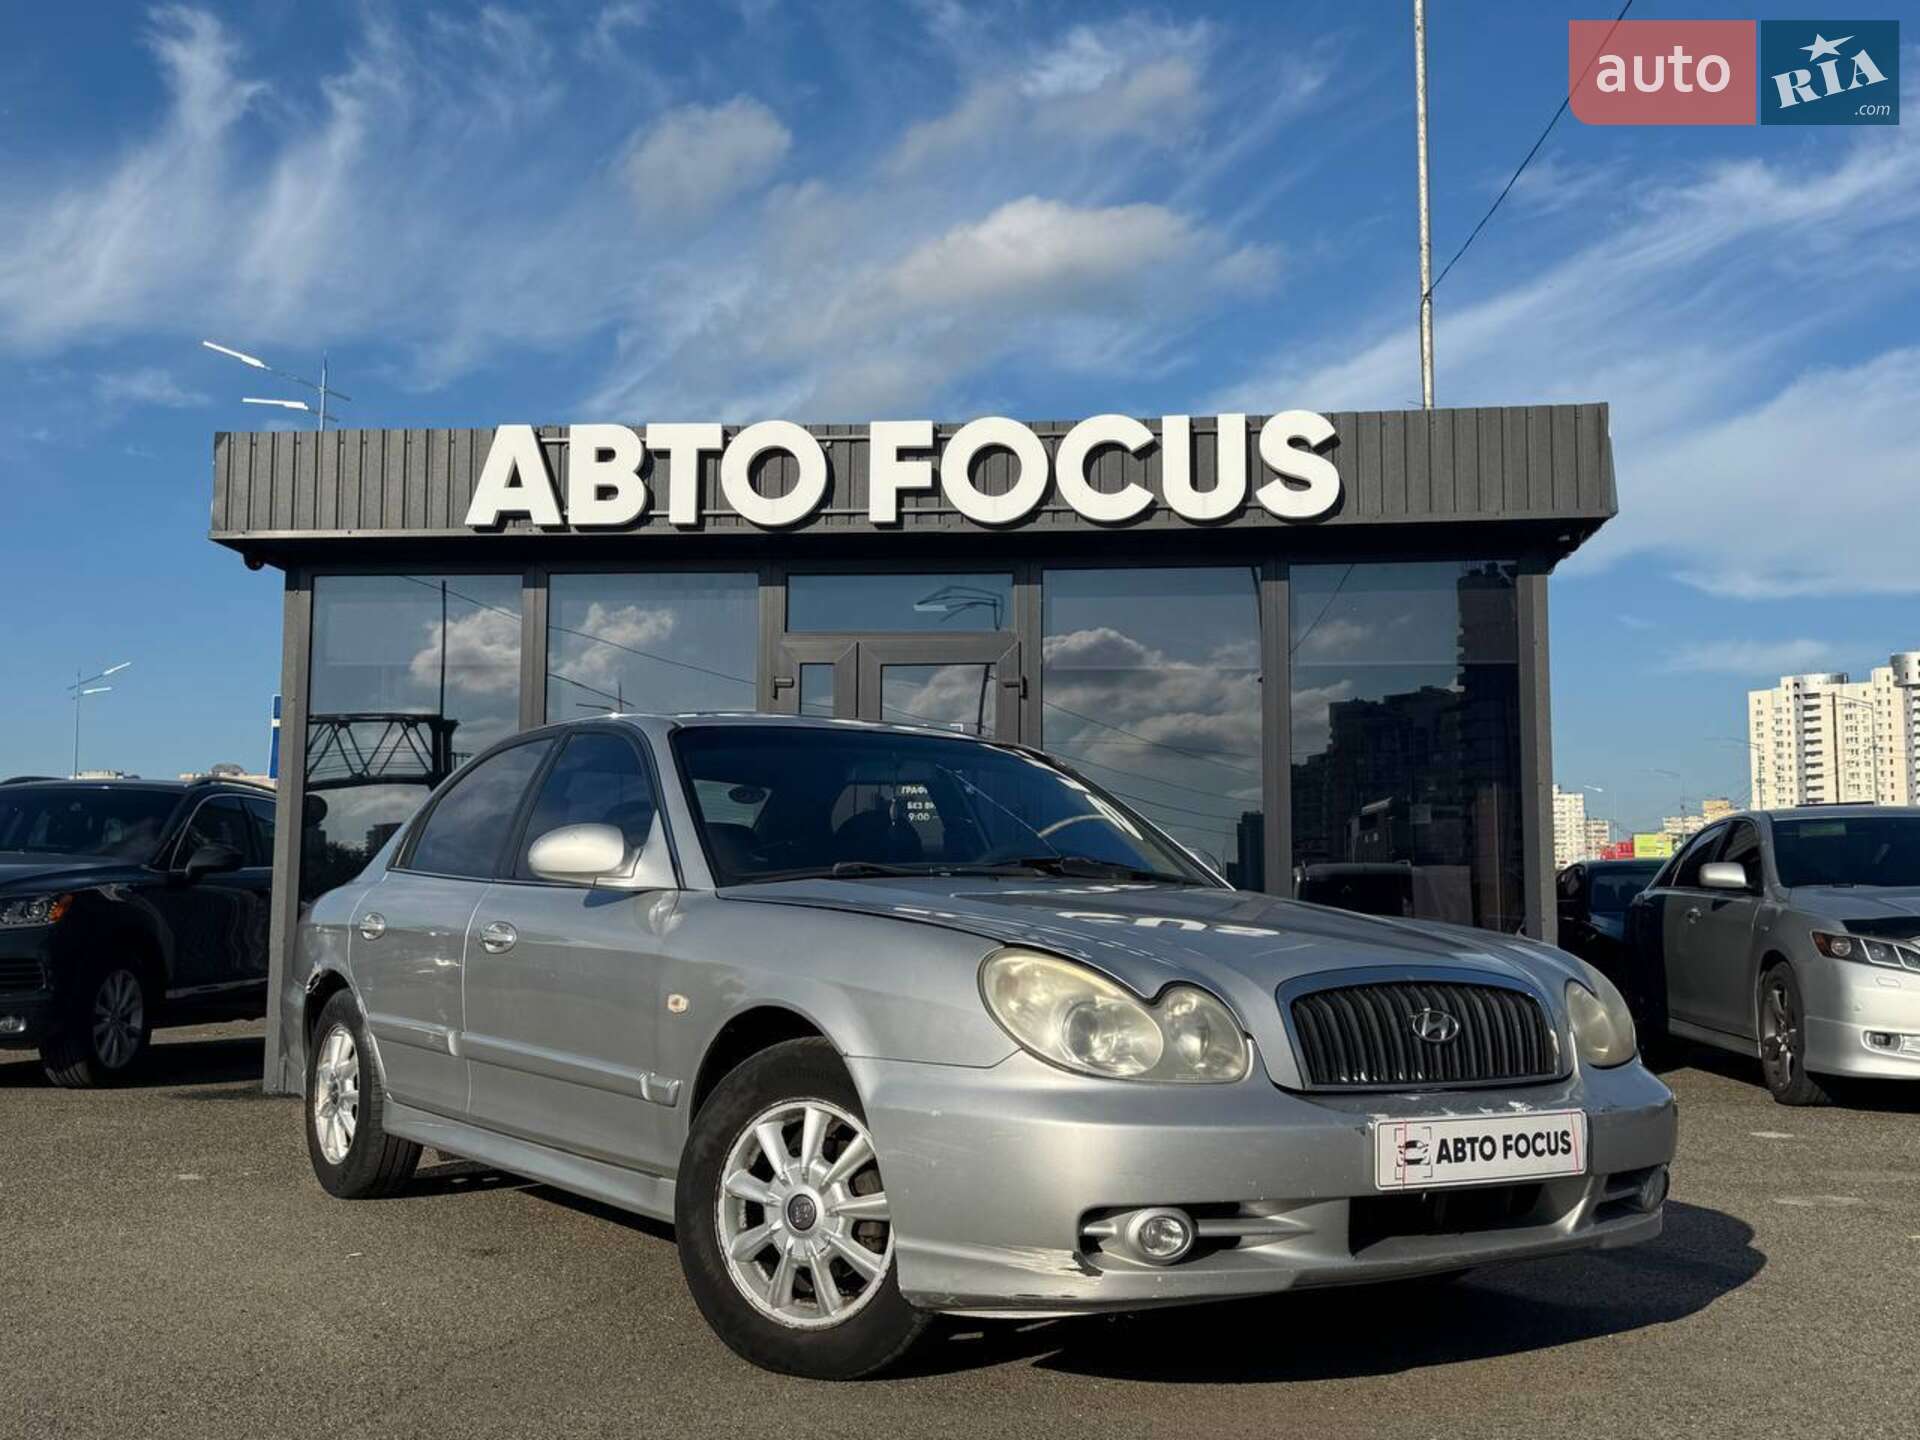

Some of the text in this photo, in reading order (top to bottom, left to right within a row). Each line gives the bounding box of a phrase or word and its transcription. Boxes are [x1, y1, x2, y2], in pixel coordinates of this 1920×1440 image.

[464, 409, 1342, 529] АВТО FOCUS
[908, 813, 930, 821] 9:00
[1436, 1130, 1572, 1165] АВТО FOCUS
